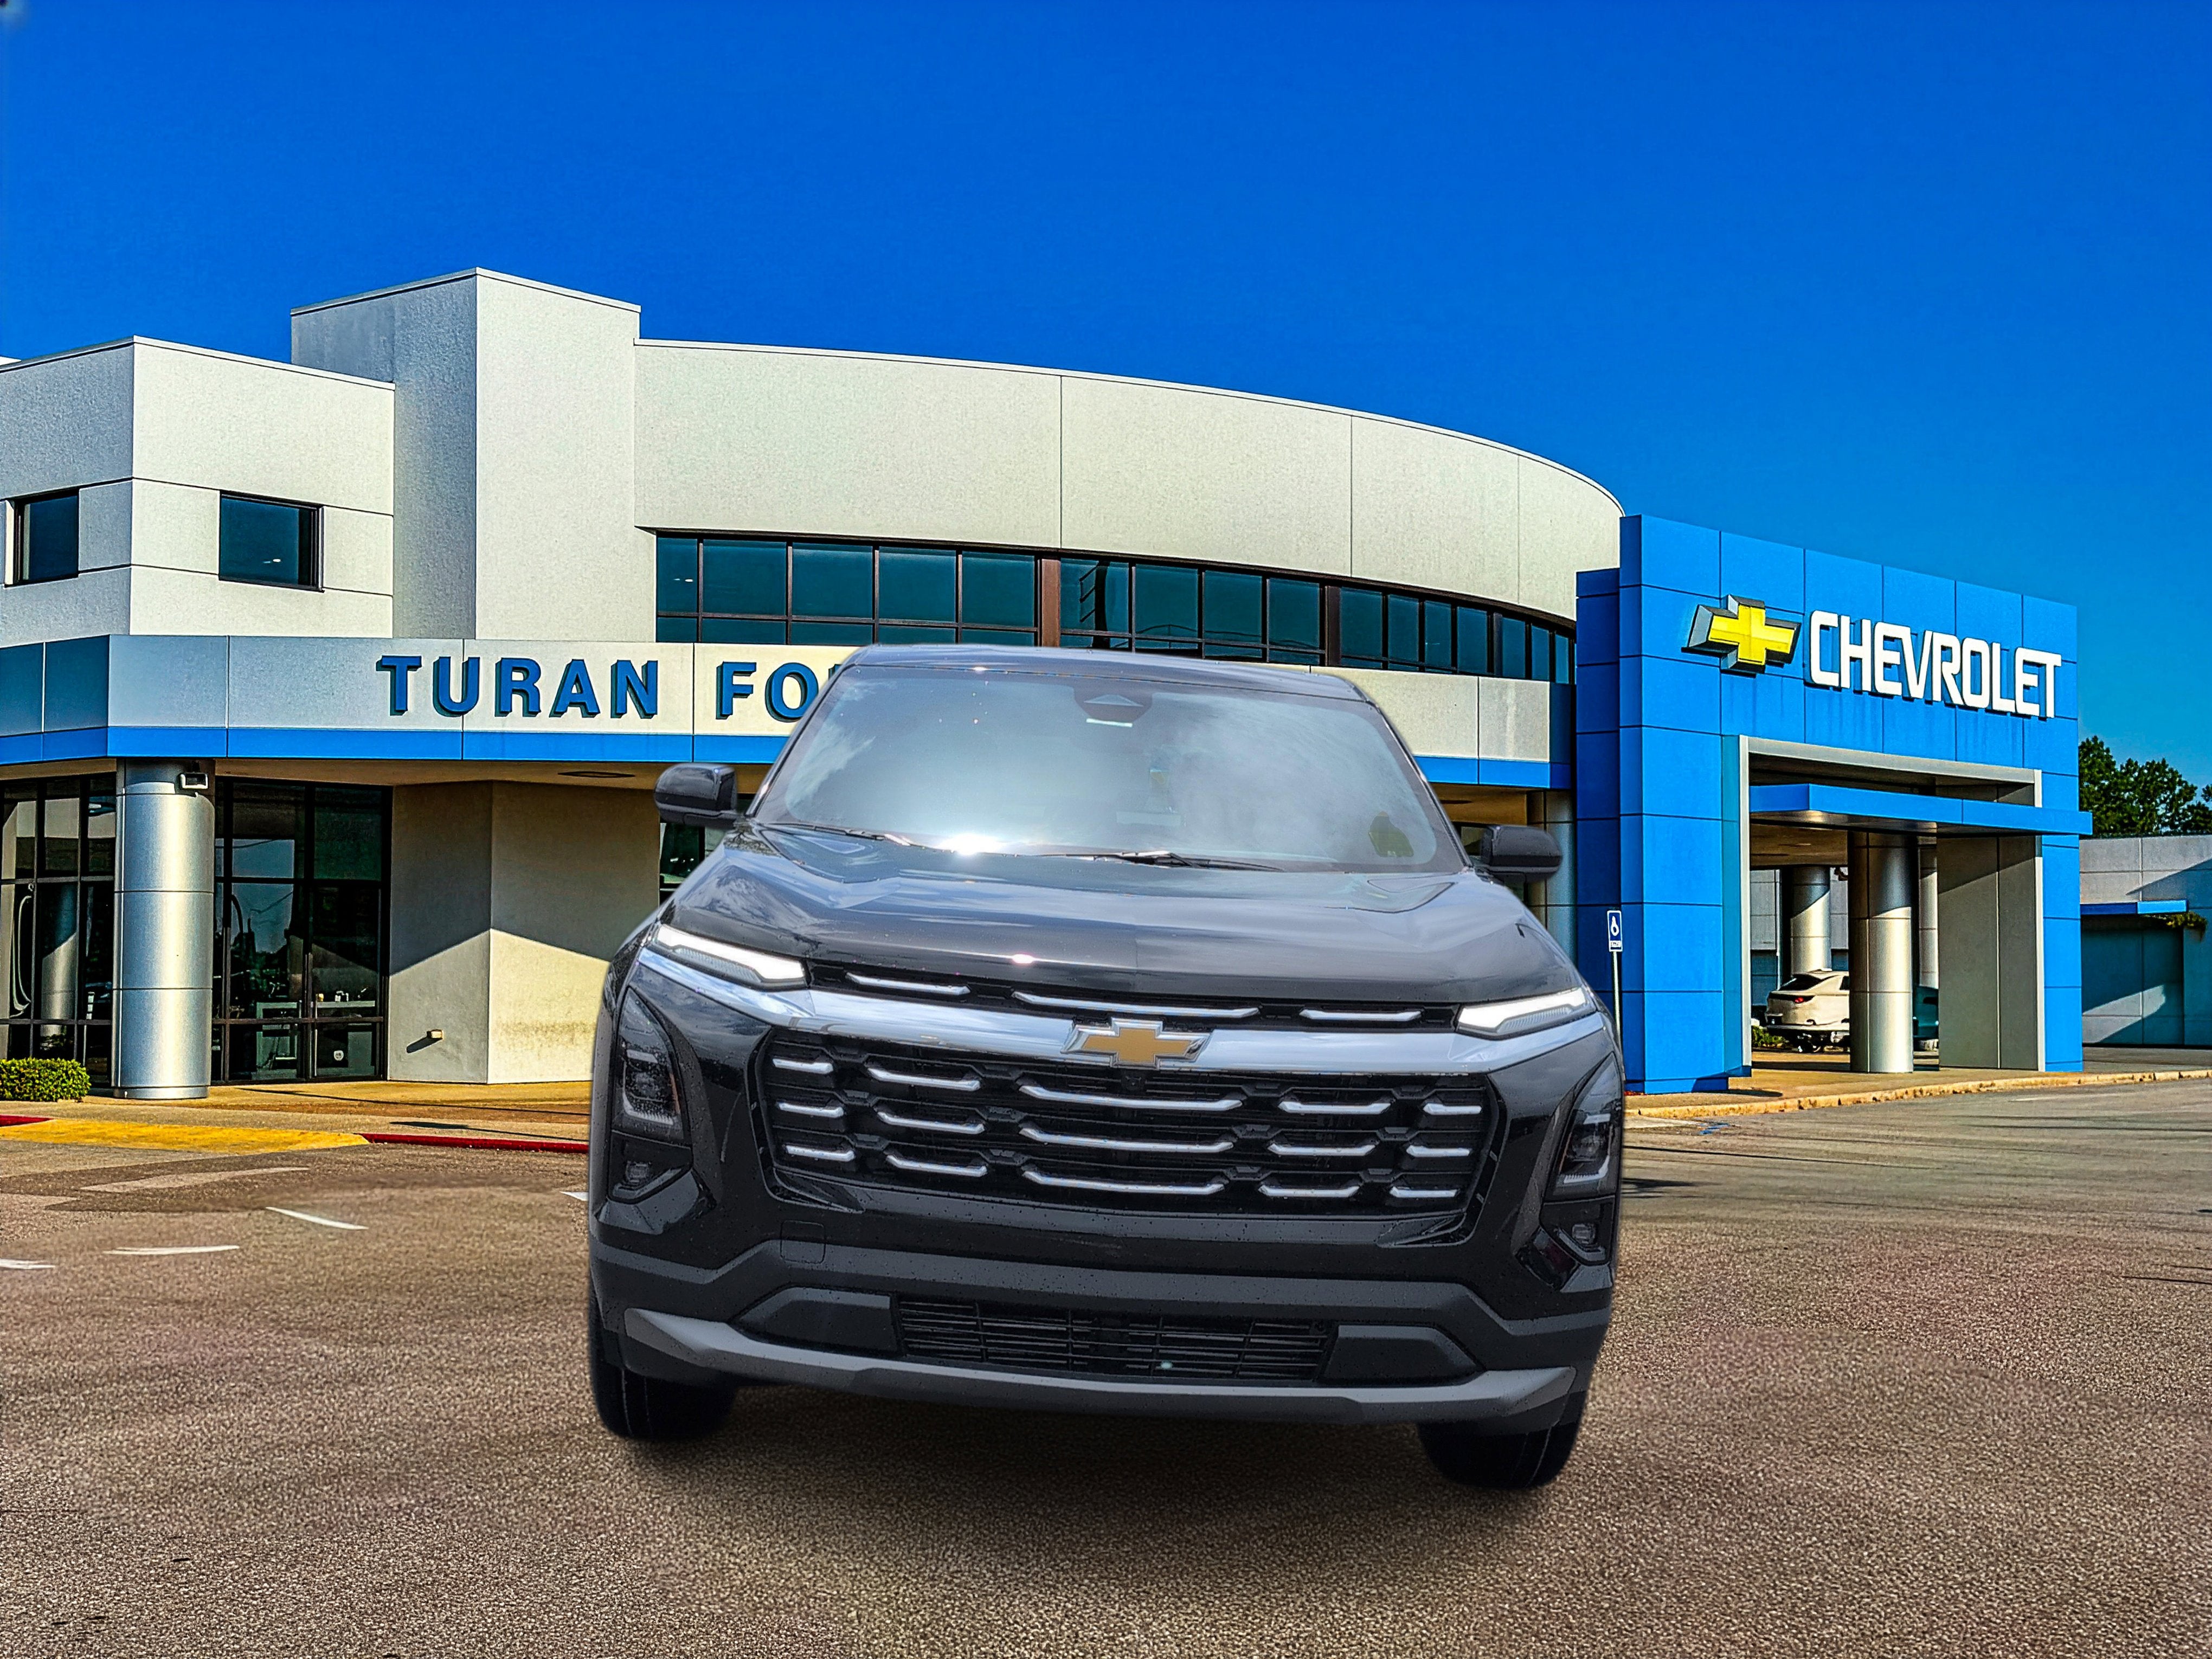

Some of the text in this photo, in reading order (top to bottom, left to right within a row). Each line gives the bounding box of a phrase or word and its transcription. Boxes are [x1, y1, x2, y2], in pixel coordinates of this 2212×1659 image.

[377, 655, 842, 723] TURAN FO
[1809, 610, 2062, 718] CHEVROLET
